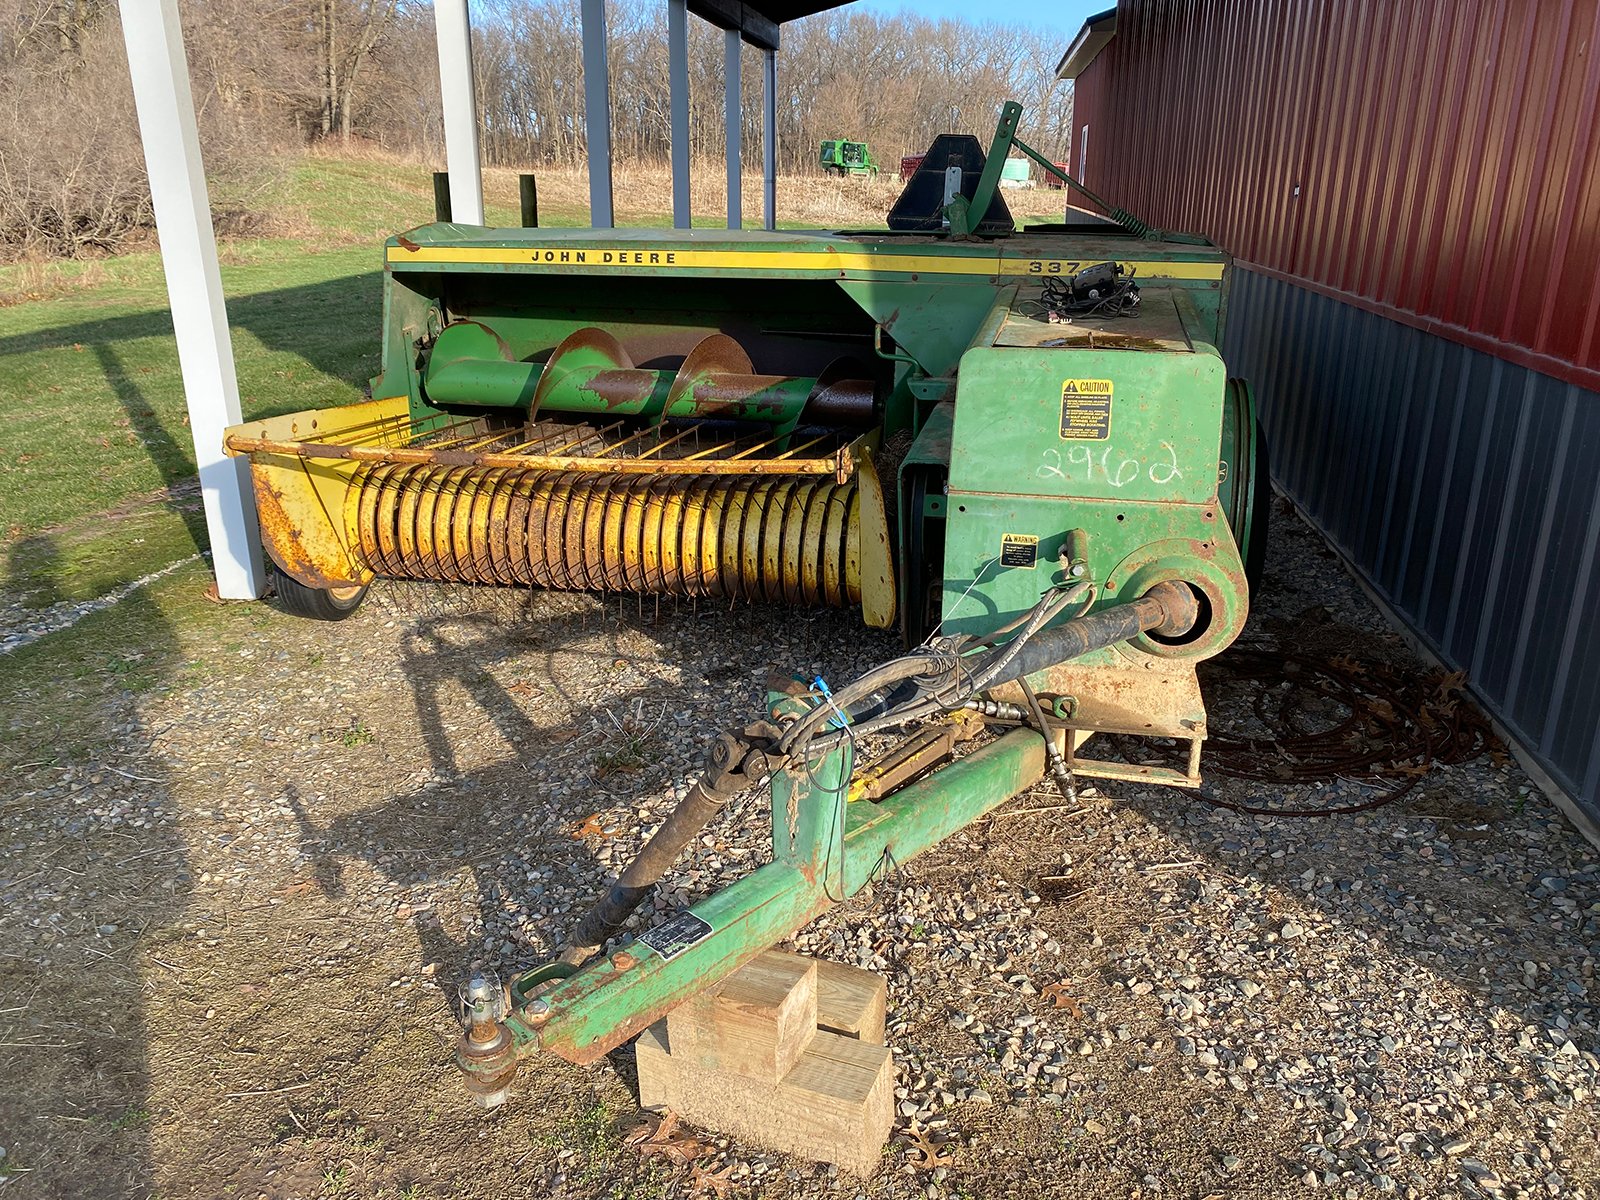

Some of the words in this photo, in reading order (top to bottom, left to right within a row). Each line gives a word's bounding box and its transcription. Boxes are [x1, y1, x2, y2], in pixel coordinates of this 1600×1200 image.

[532, 251, 586, 263] JOHN
[603, 252, 676, 264] DEERE
[1029, 261, 1081, 274] 337
[1080, 382, 1109, 393] CAUTION
[1036, 440, 1183, 488] 2962
[1013, 536, 1038, 545] WARNING
